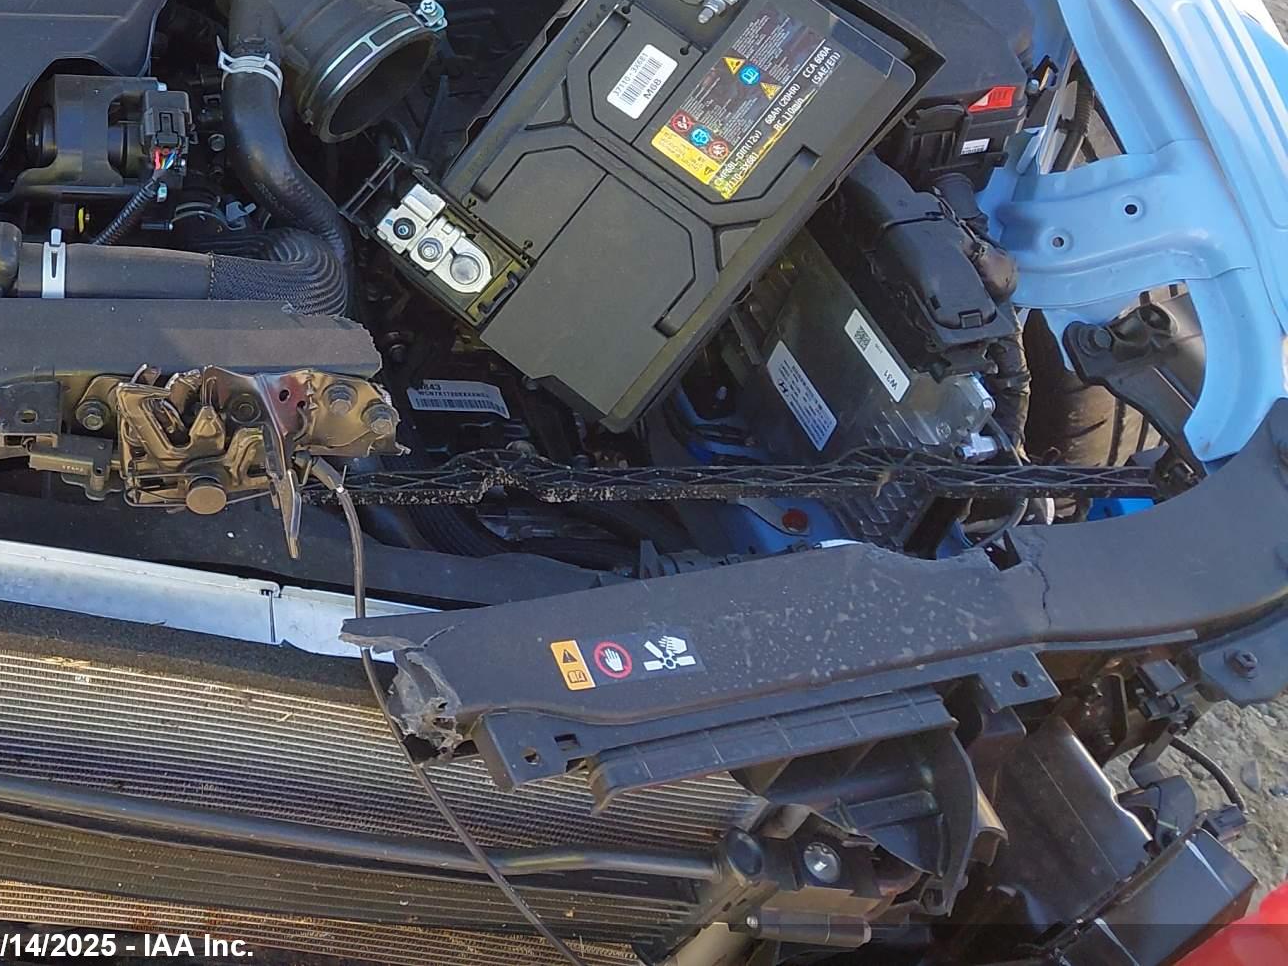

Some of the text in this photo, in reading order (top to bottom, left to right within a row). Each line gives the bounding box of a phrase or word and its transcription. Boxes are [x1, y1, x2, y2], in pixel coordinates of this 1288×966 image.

[764, 103, 783, 125] 68Ah
[802, 61, 819, 79] CCA
[815, 46, 833, 65] 600A
